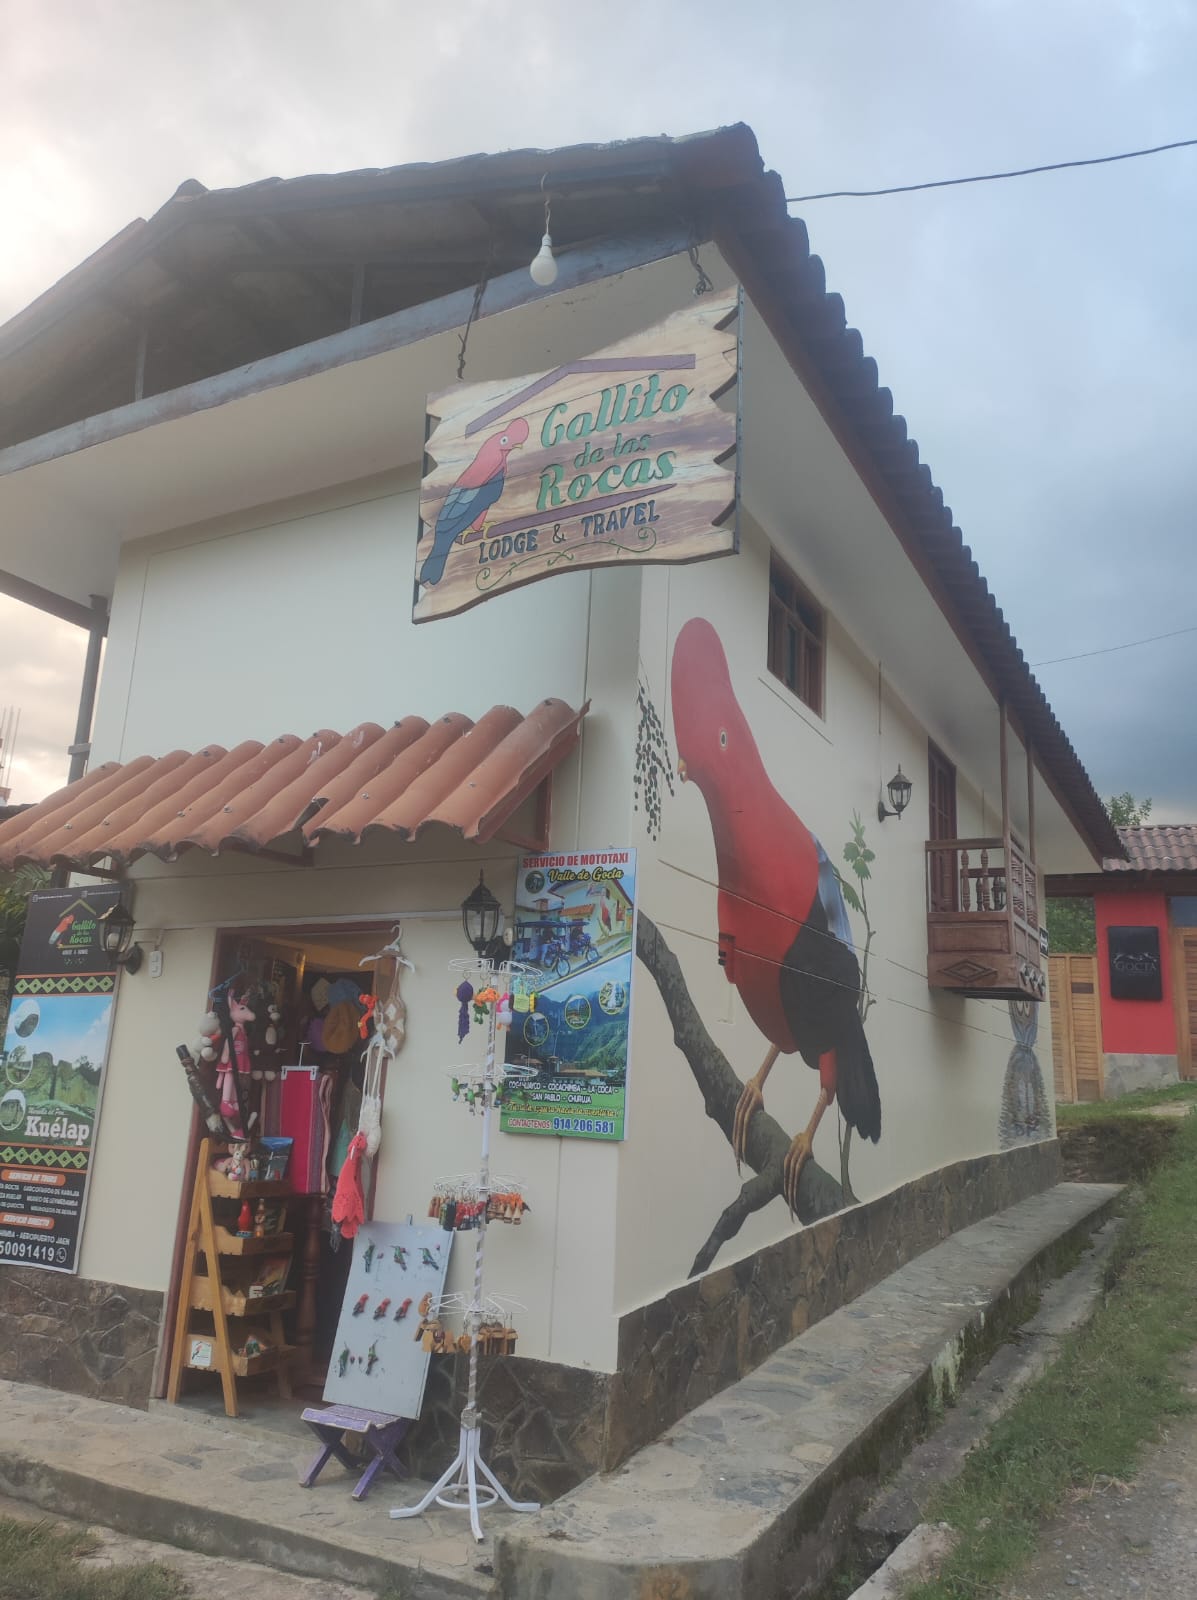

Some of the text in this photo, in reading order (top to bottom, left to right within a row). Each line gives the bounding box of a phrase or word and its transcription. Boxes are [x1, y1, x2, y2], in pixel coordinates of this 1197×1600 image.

[540, 373, 695, 450] Gallito
[574, 432, 652, 471] de las
[478, 499, 661, 564] LODGE & TRAVEL
[523, 852, 629, 868] SERVICIO DE MOTOTAXI
[548, 866, 624, 882] Valle de Gocta
[544, 1094, 560, 1102] PABLO
[24, 1116, 90, 1145] Kuélap
[553, 1118, 571, 1130] 914
[574, 1119, 593, 1132] 206
[595, 1121, 615, 1134] 581
